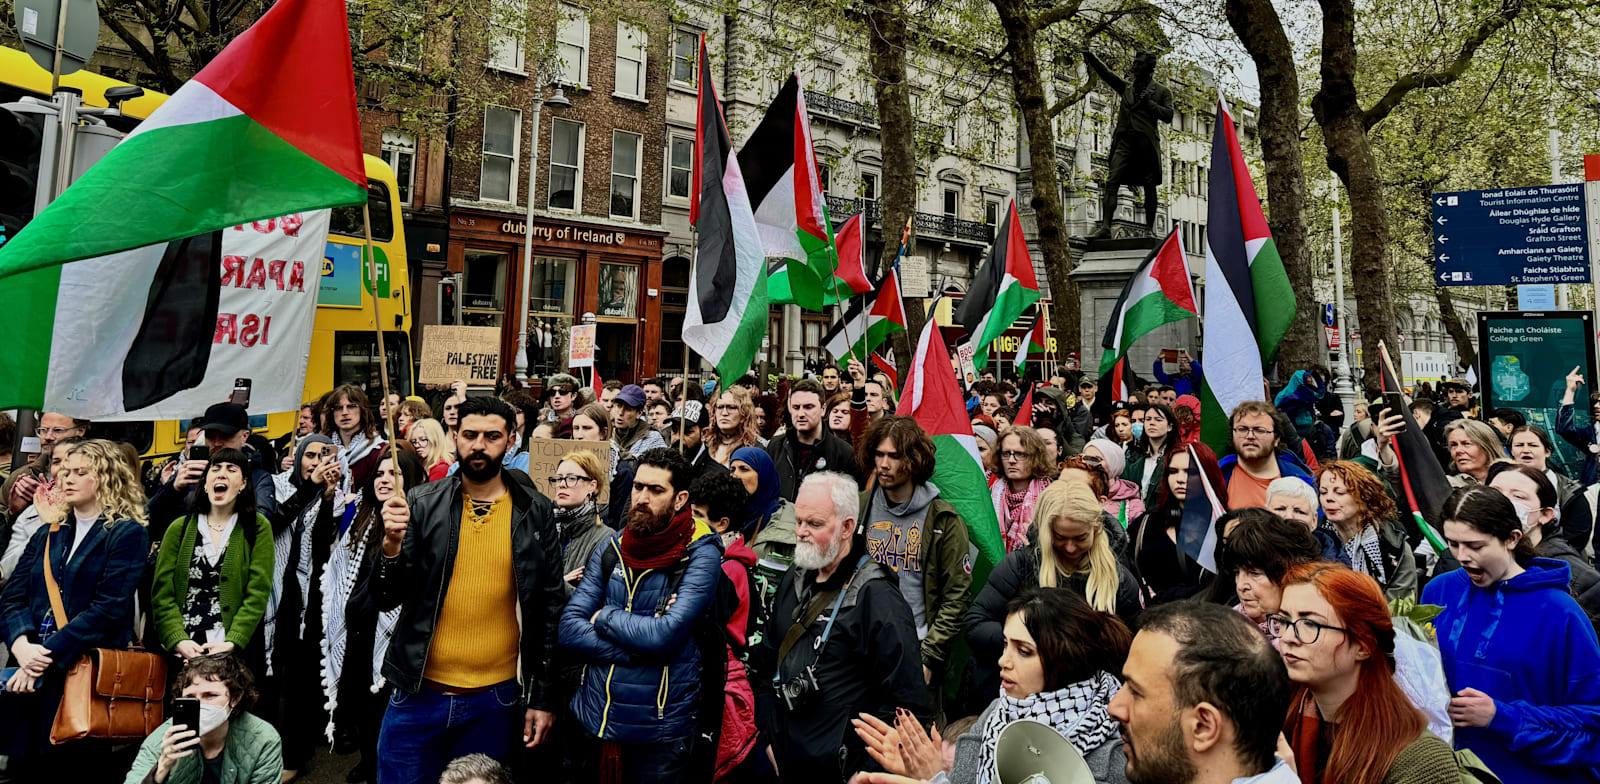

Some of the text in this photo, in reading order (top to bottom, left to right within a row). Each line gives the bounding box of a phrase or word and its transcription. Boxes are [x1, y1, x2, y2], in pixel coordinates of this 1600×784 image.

[1482, 191, 1503, 199] Ionad
[1507, 196, 1551, 204] Information
[1499, 214, 1580, 225] Douglas Hyde Gallery
[502, 220, 613, 244] dubrry of Ireland
[1528, 226, 1549, 234] Sráid
[1557, 246, 1583, 254] Gaiety
[1526, 255, 1552, 263] Gaiety
[365, 262, 387, 282] TFI
[1522, 274, 1559, 283] Stephen's
[1490, 335, 1518, 343] College
[446, 352, 498, 366] PALESTINE
[471, 366, 496, 380] FREE
[534, 441, 564, 457] TCD
